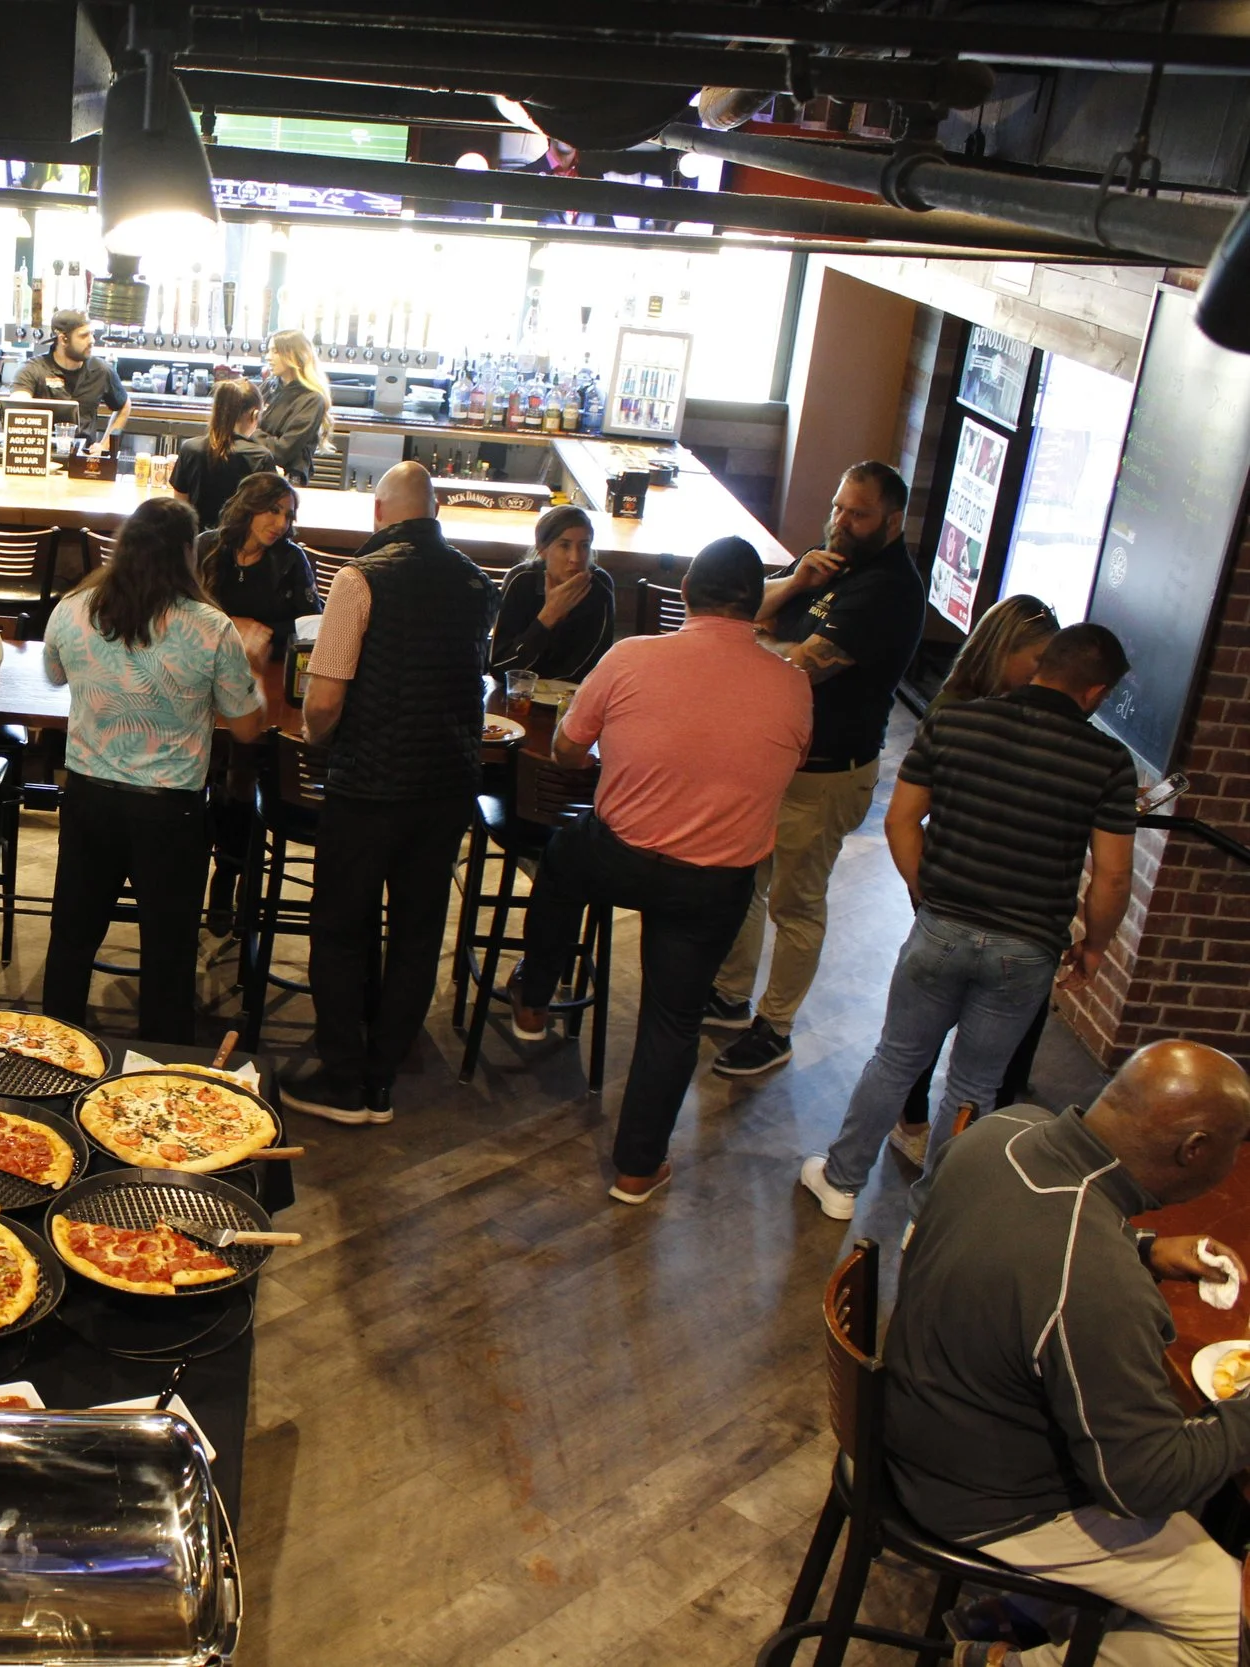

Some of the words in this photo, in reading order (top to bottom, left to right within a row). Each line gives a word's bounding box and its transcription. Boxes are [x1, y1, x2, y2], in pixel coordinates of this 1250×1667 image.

[972, 327, 1030, 367] REVOLUTIONS
[14, 417, 26, 425] NO
[26, 418, 42, 426] ONE
[8, 427, 33, 435] UNDER
[9, 446, 44, 455] ALLOWED
[447, 492, 466, 505] JACK
[466, 491, 495, 508] DANIEL'S
[1116, 690, 1136, 720] 21+
